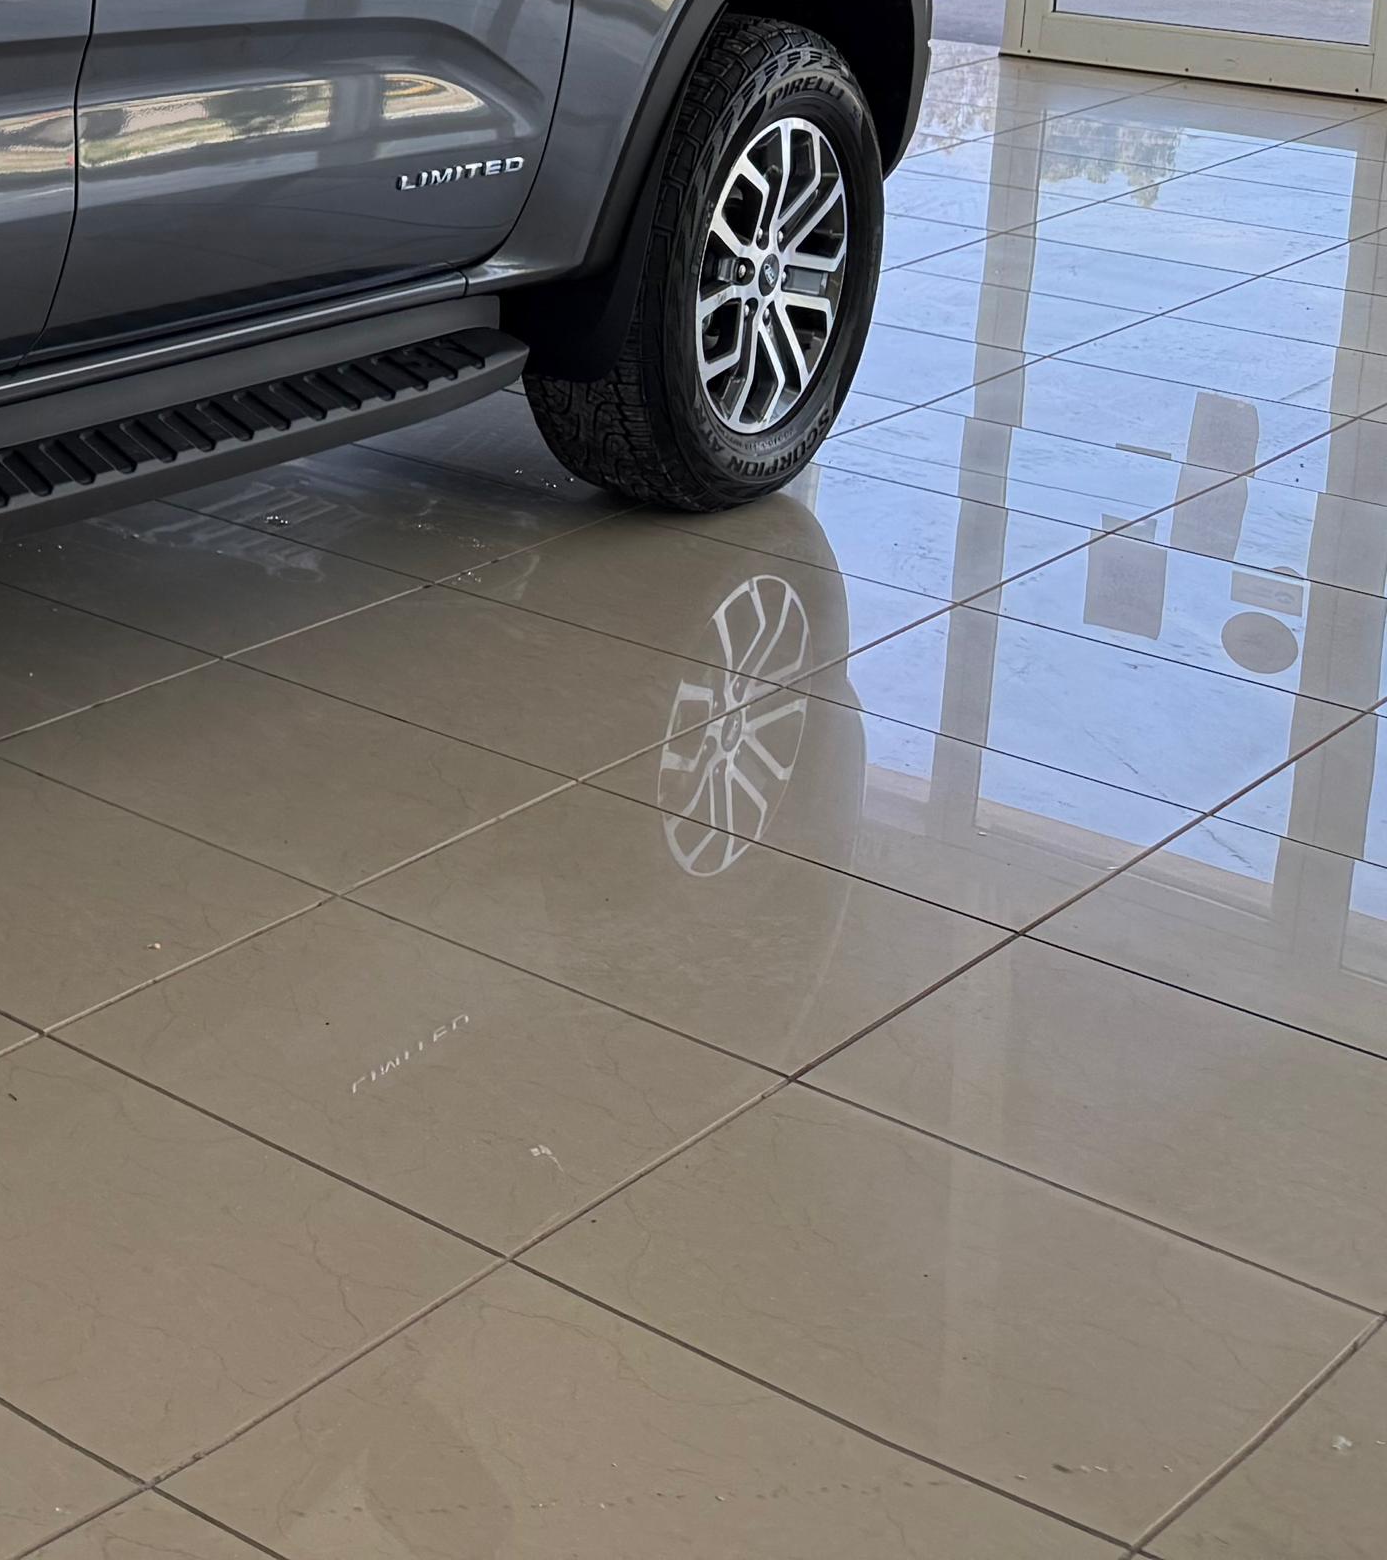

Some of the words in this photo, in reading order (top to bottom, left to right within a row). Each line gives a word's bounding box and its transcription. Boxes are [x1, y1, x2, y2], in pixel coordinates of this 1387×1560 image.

[768, 74, 845, 110] PIRELLI
[396, 156, 525, 191] LIMITED
[728, 408, 830, 478] SCORPION
